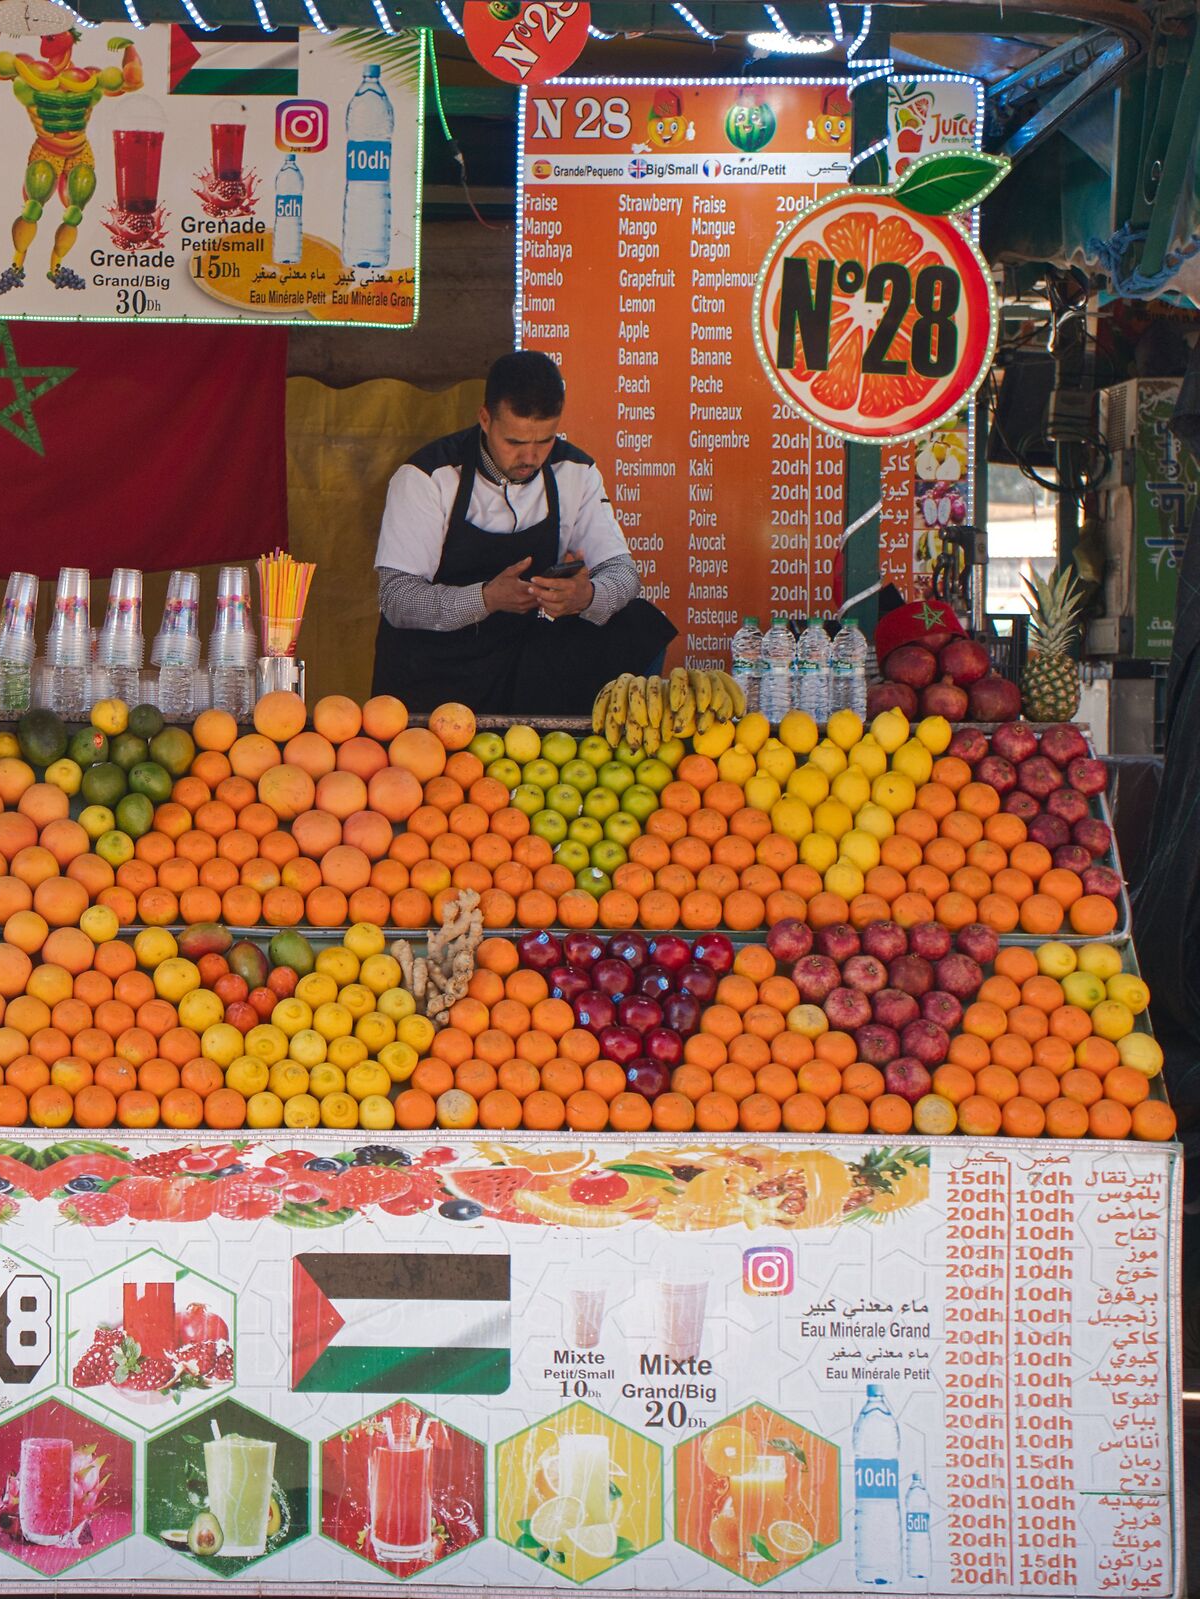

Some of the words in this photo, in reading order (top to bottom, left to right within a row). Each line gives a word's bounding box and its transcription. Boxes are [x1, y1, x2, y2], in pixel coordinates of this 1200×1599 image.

[574, 97, 632, 139] 28
[348, 150, 389, 169] 10dh
[554, 164, 624, 179] Grande/Pequeno
[645, 162, 698, 176] Big/Small
[723, 163, 786, 177] Grand/Petit
[277, 199, 300, 216] 5dh
[523, 194, 558, 211] Fraise
[618, 195, 683, 215] Strawberry
[692, 196, 727, 214] Fraise
[181, 217, 265, 234] Grenade
[182, 238, 265, 251] Petit/small
[523, 240, 573, 260] Pitahaya
[618, 242, 660, 260] Dragon
[691, 241, 731, 259] Dragon
[91, 250, 175, 269] Grenade
[93, 275, 170, 290] Grand/Big
[280, 269, 306, 286] معدني
[310, 268, 325, 280] ماء
[334, 272, 355, 285] كبير
[360, 271, 393, 287] معدني
[250, 291, 266, 303] Eau
[269, 289, 305, 304] Minérale
[307, 291, 326, 304] Petit
[332, 291, 348, 305] Eau
[351, 291, 388, 305] Minérale
[776, 257, 961, 379] N°28
[523, 321, 570, 339] Manzana
[618, 321, 649, 341] Apple
[691, 323, 732, 341] Pomme
[616, 460, 676, 478] Persimmon
[689, 460, 713, 476] Kaki
[771, 460, 809, 475] 20dh
[950, 1152, 1007, 1170] كبير
[948, 1171, 1005, 1185] 15dh
[802, 1299, 836, 1316] كبير
[843, 1299, 893, 1318] معدني
[900, 1300, 928, 1314] ماء
[802, 1322, 825, 1337] Eau
[830, 1322, 885, 1338] Minérale
[890, 1323, 930, 1338] Grand
[552, 1350, 605, 1366] Mixte
[828, 1347, 861, 1361] صغير
[866, 1348, 902, 1363] معدني
[908, 1349, 928, 1359] ماء
[640, 1354, 712, 1377] Mixte
[827, 1368, 848, 1379] Eau
[852, 1367, 900, 1380] Minérale
[904, 1368, 930, 1380] Petit
[544, 1368, 615, 1383] Petit/Small
[621, 1383, 717, 1402] Grand/Big
[946, 1454, 1005, 1468] 30dh
[1016, 1455, 1073, 1470] 15dh
[1119, 1454, 1161, 1470] رمان
[855, 1467, 896, 1489] 10dh
[907, 1515, 928, 1532] 5dh
